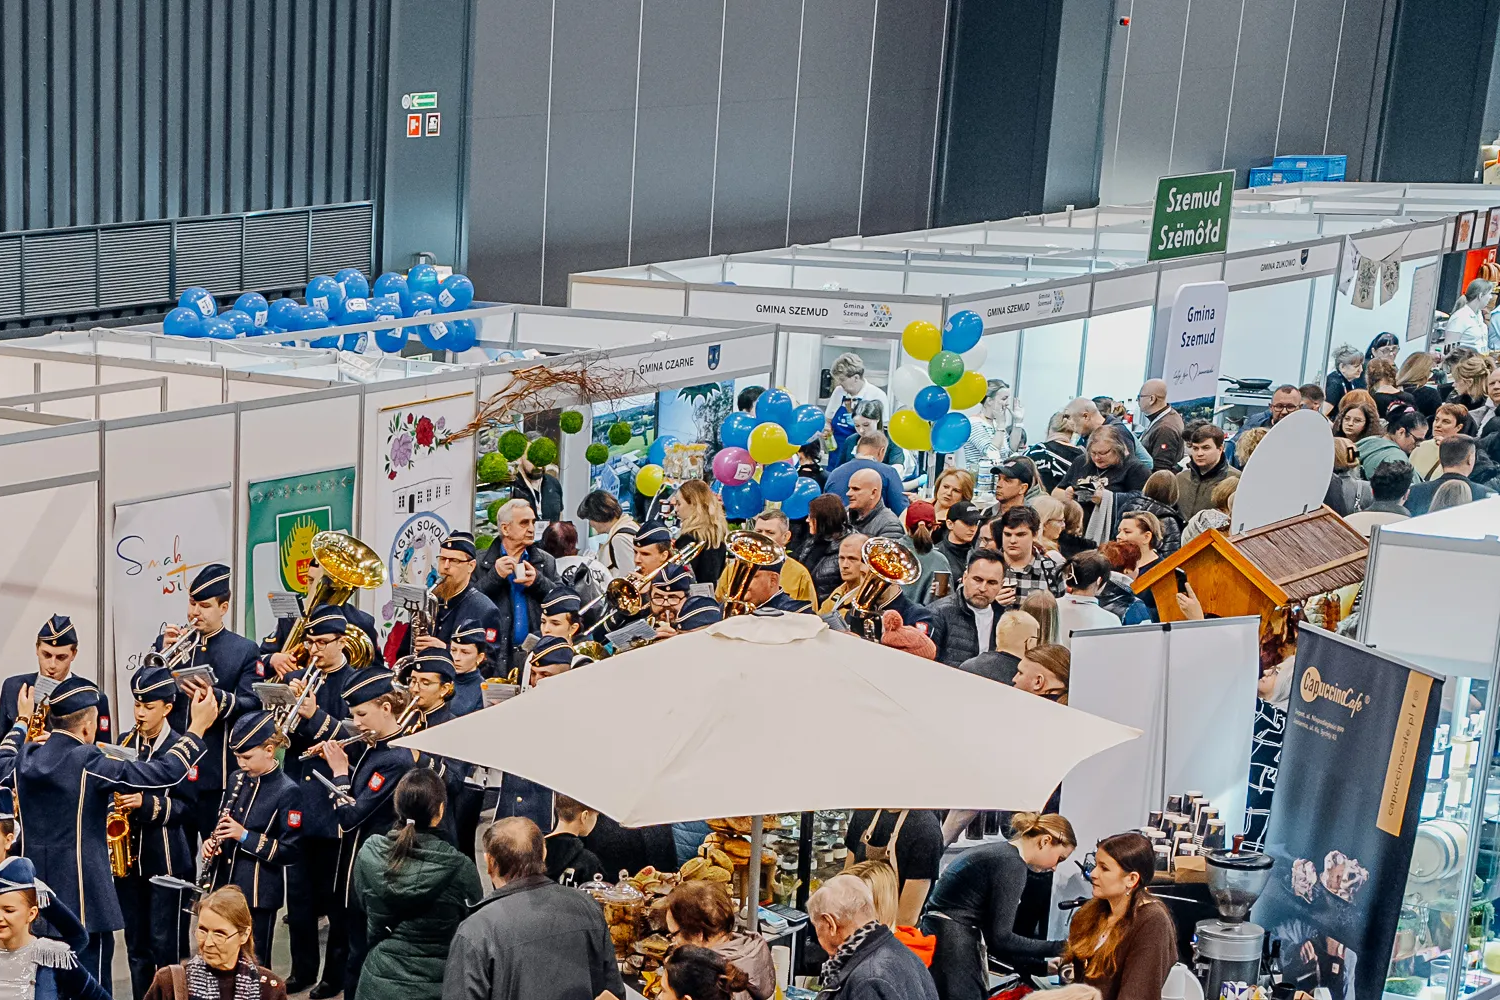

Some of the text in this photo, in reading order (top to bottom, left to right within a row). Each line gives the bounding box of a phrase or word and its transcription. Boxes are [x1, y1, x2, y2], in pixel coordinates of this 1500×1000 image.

[1166, 182, 1223, 213] Szemud
[1158, 218, 1222, 251] Szëmôłd
[756, 304, 829, 317] GMINA SZEMUD
[843, 302, 865, 310] Gmina
[987, 306, 1006, 317] GMINA
[1007, 302, 1030, 314] SZEMUD
[1187, 305, 1215, 323] Gmina
[1180, 328, 1216, 348] Szemud
[639, 356, 694, 375] GMINA CZARNE
[116, 535, 184, 576] Smak
[1388, 713, 1415, 816] capuccinocafe.pl
